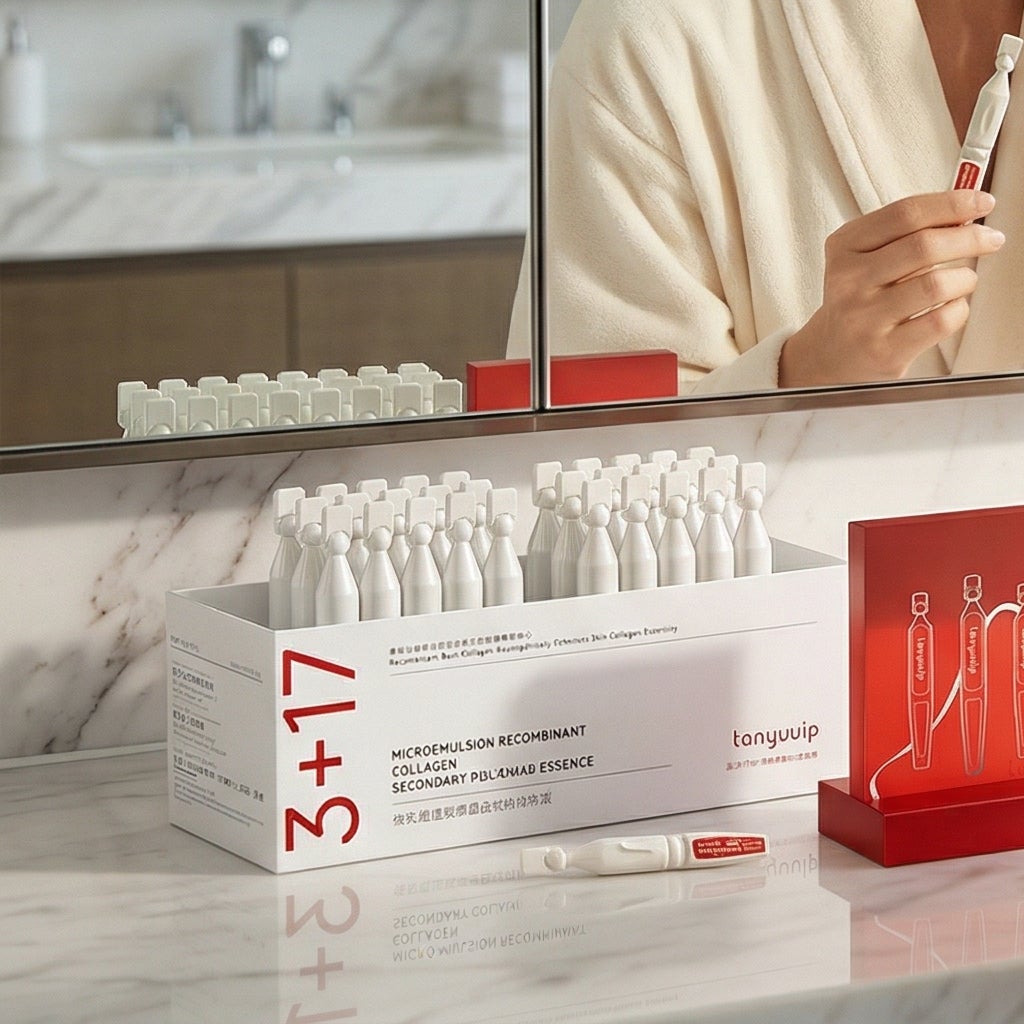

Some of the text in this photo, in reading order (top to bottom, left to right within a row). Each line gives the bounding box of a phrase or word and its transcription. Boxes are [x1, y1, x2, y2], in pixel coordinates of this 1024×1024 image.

[282, 649, 359, 852] 3+17
[391, 725, 587, 761] MICROEMULSION RECOMBINANT
[733, 721, 819, 749] tanyuuip
[391, 758, 458, 778] COLLAGEN
[391, 772, 468, 794] SECONDARY
[539, 755, 595, 774] ESSENCE
